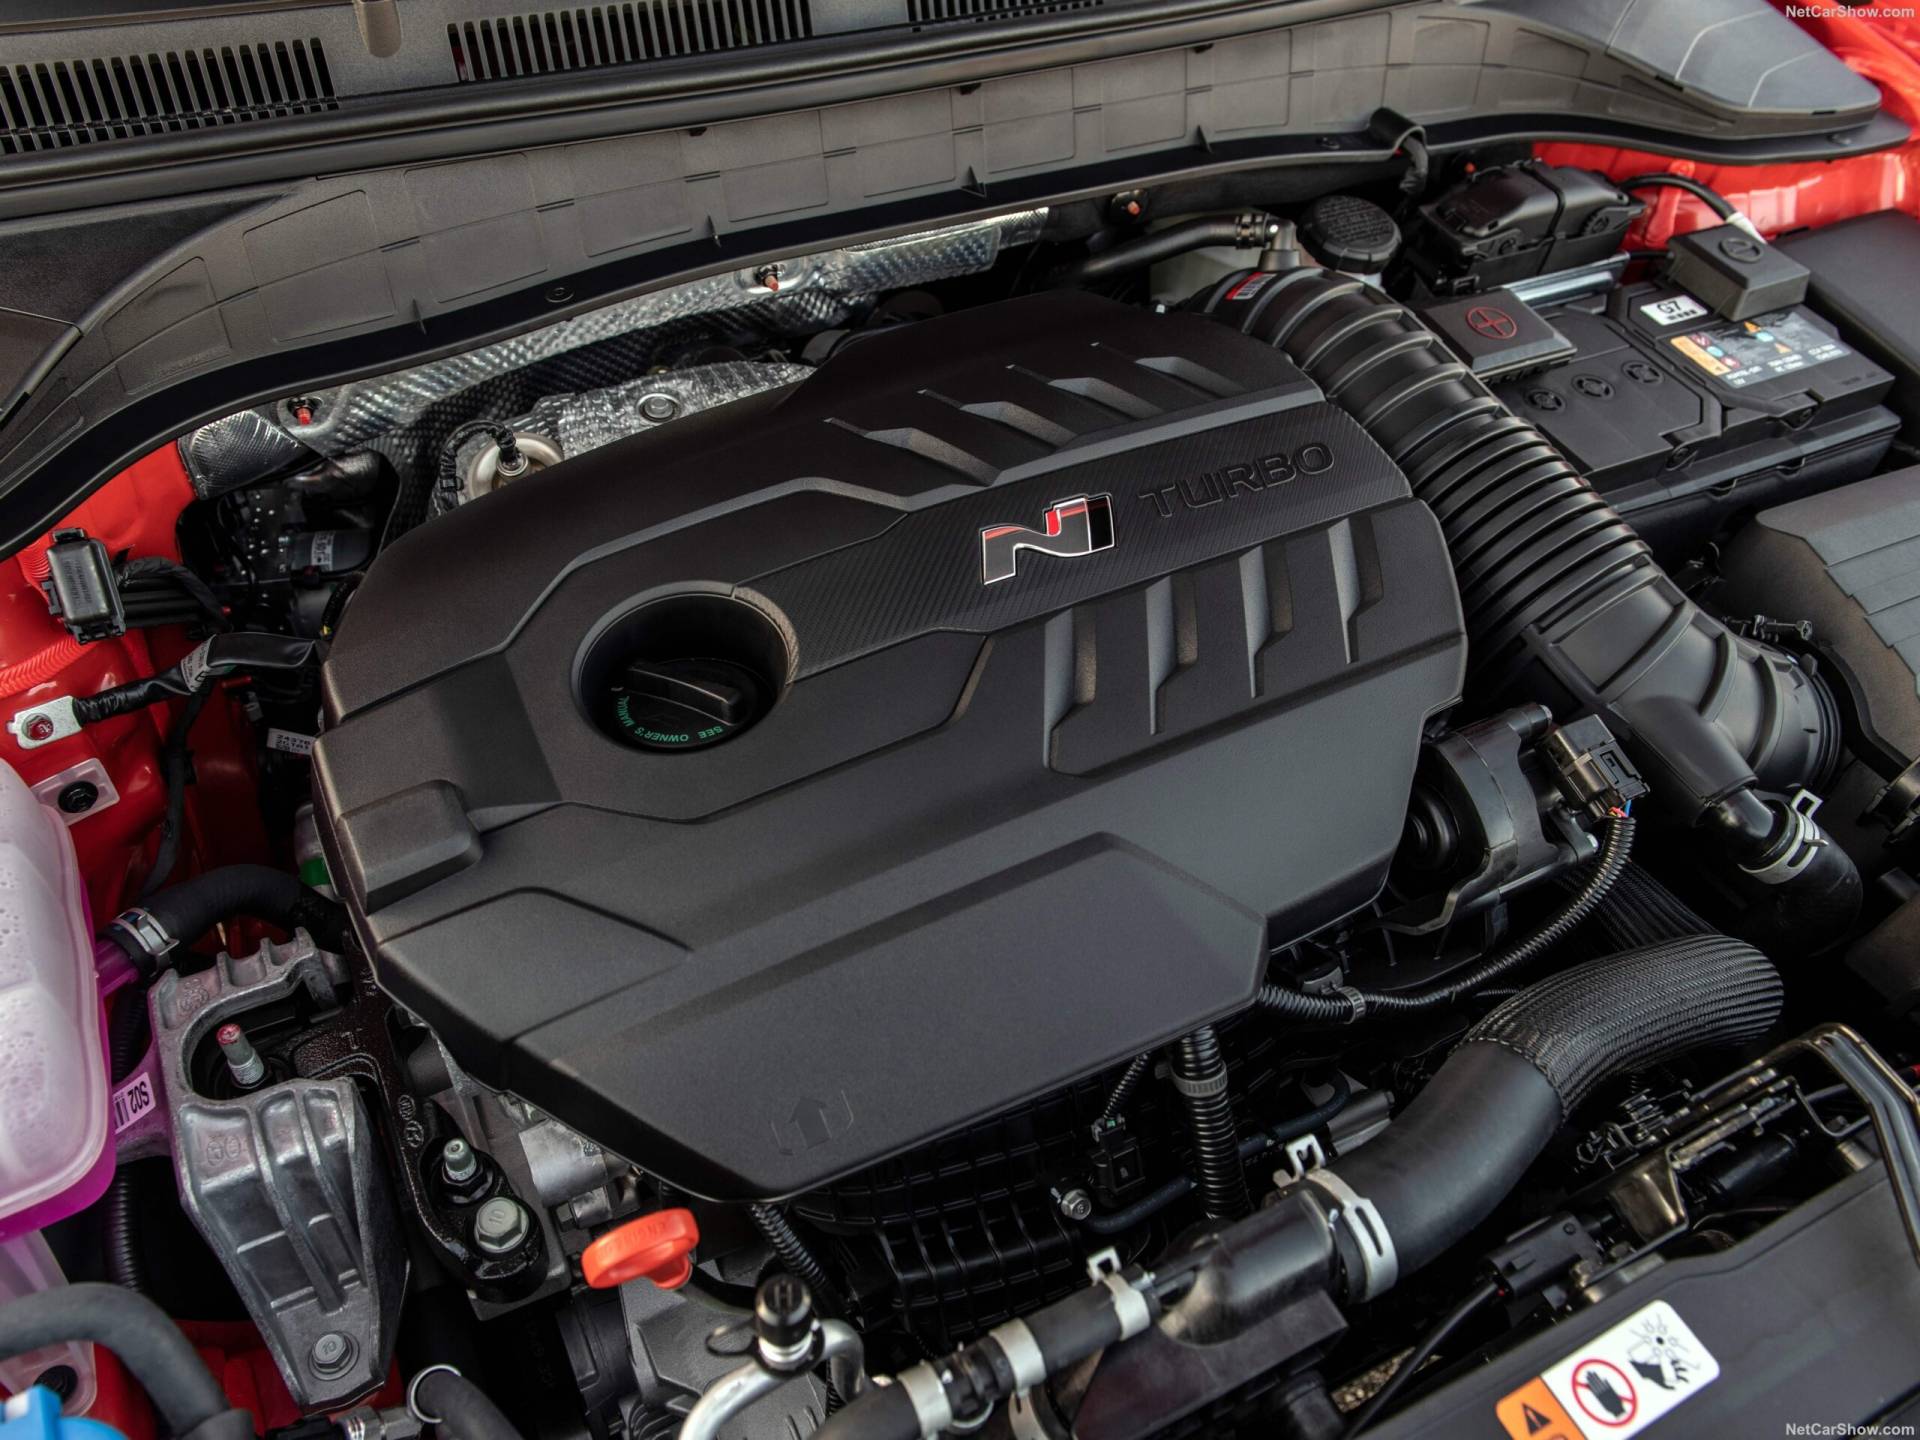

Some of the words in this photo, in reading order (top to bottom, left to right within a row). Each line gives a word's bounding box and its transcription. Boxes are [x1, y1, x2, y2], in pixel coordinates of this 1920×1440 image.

[1657, 300, 1683, 313] G7
[1138, 442, 1335, 518] TURBO
[634, 726, 690, 742] OWNER'S
[697, 725, 723, 739] SEE
[127, 1081, 150, 1114] S02
